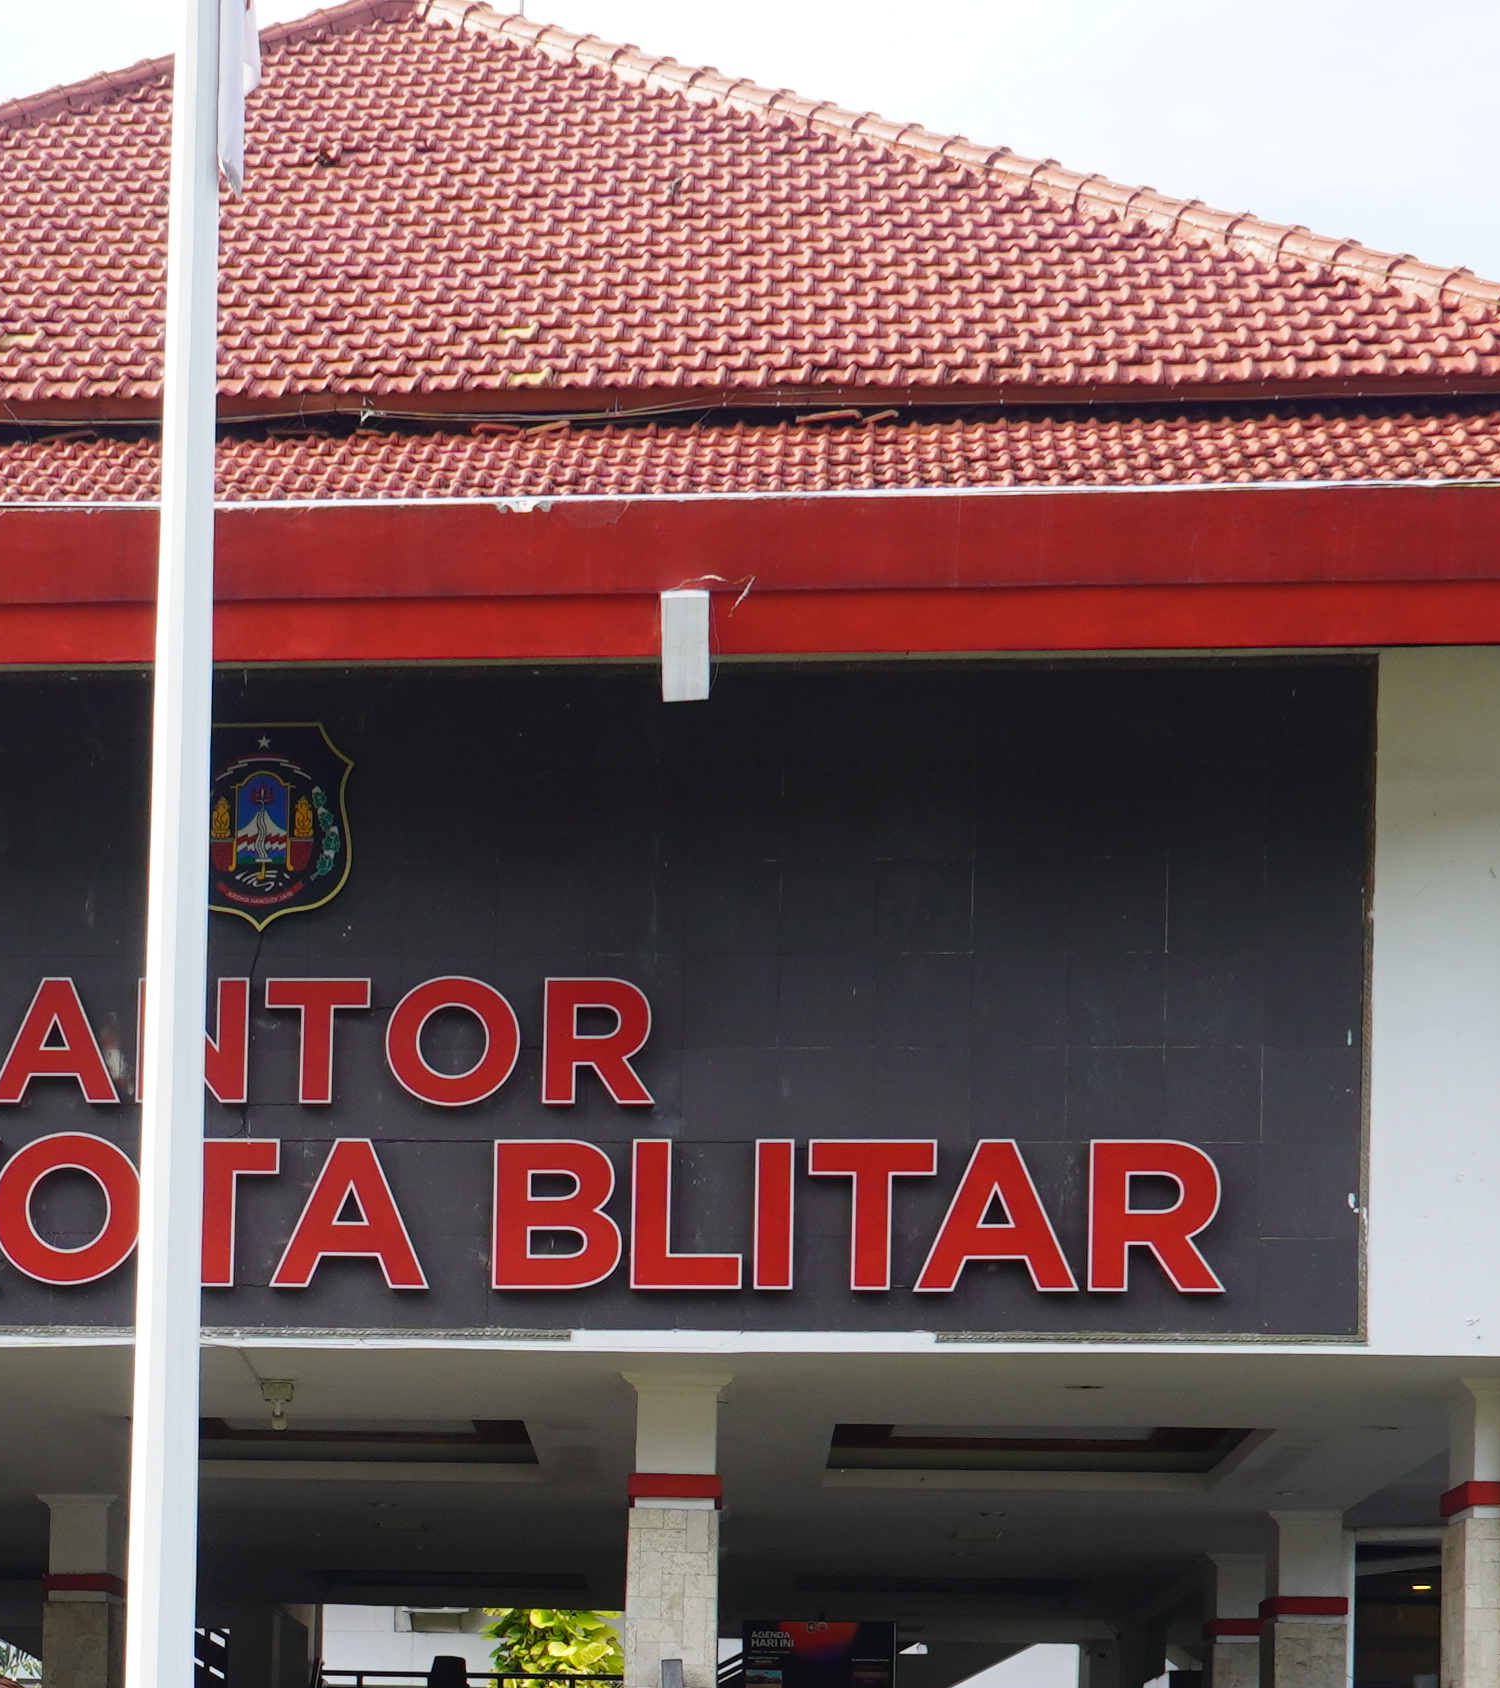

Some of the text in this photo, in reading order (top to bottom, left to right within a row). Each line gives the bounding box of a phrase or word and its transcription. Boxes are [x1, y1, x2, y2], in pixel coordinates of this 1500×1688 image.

[490, 1136, 1226, 1293] BLITAR
[751, 1630, 791, 1639] AGENDA
[751, 1639, 795, 1648] HARI INI
